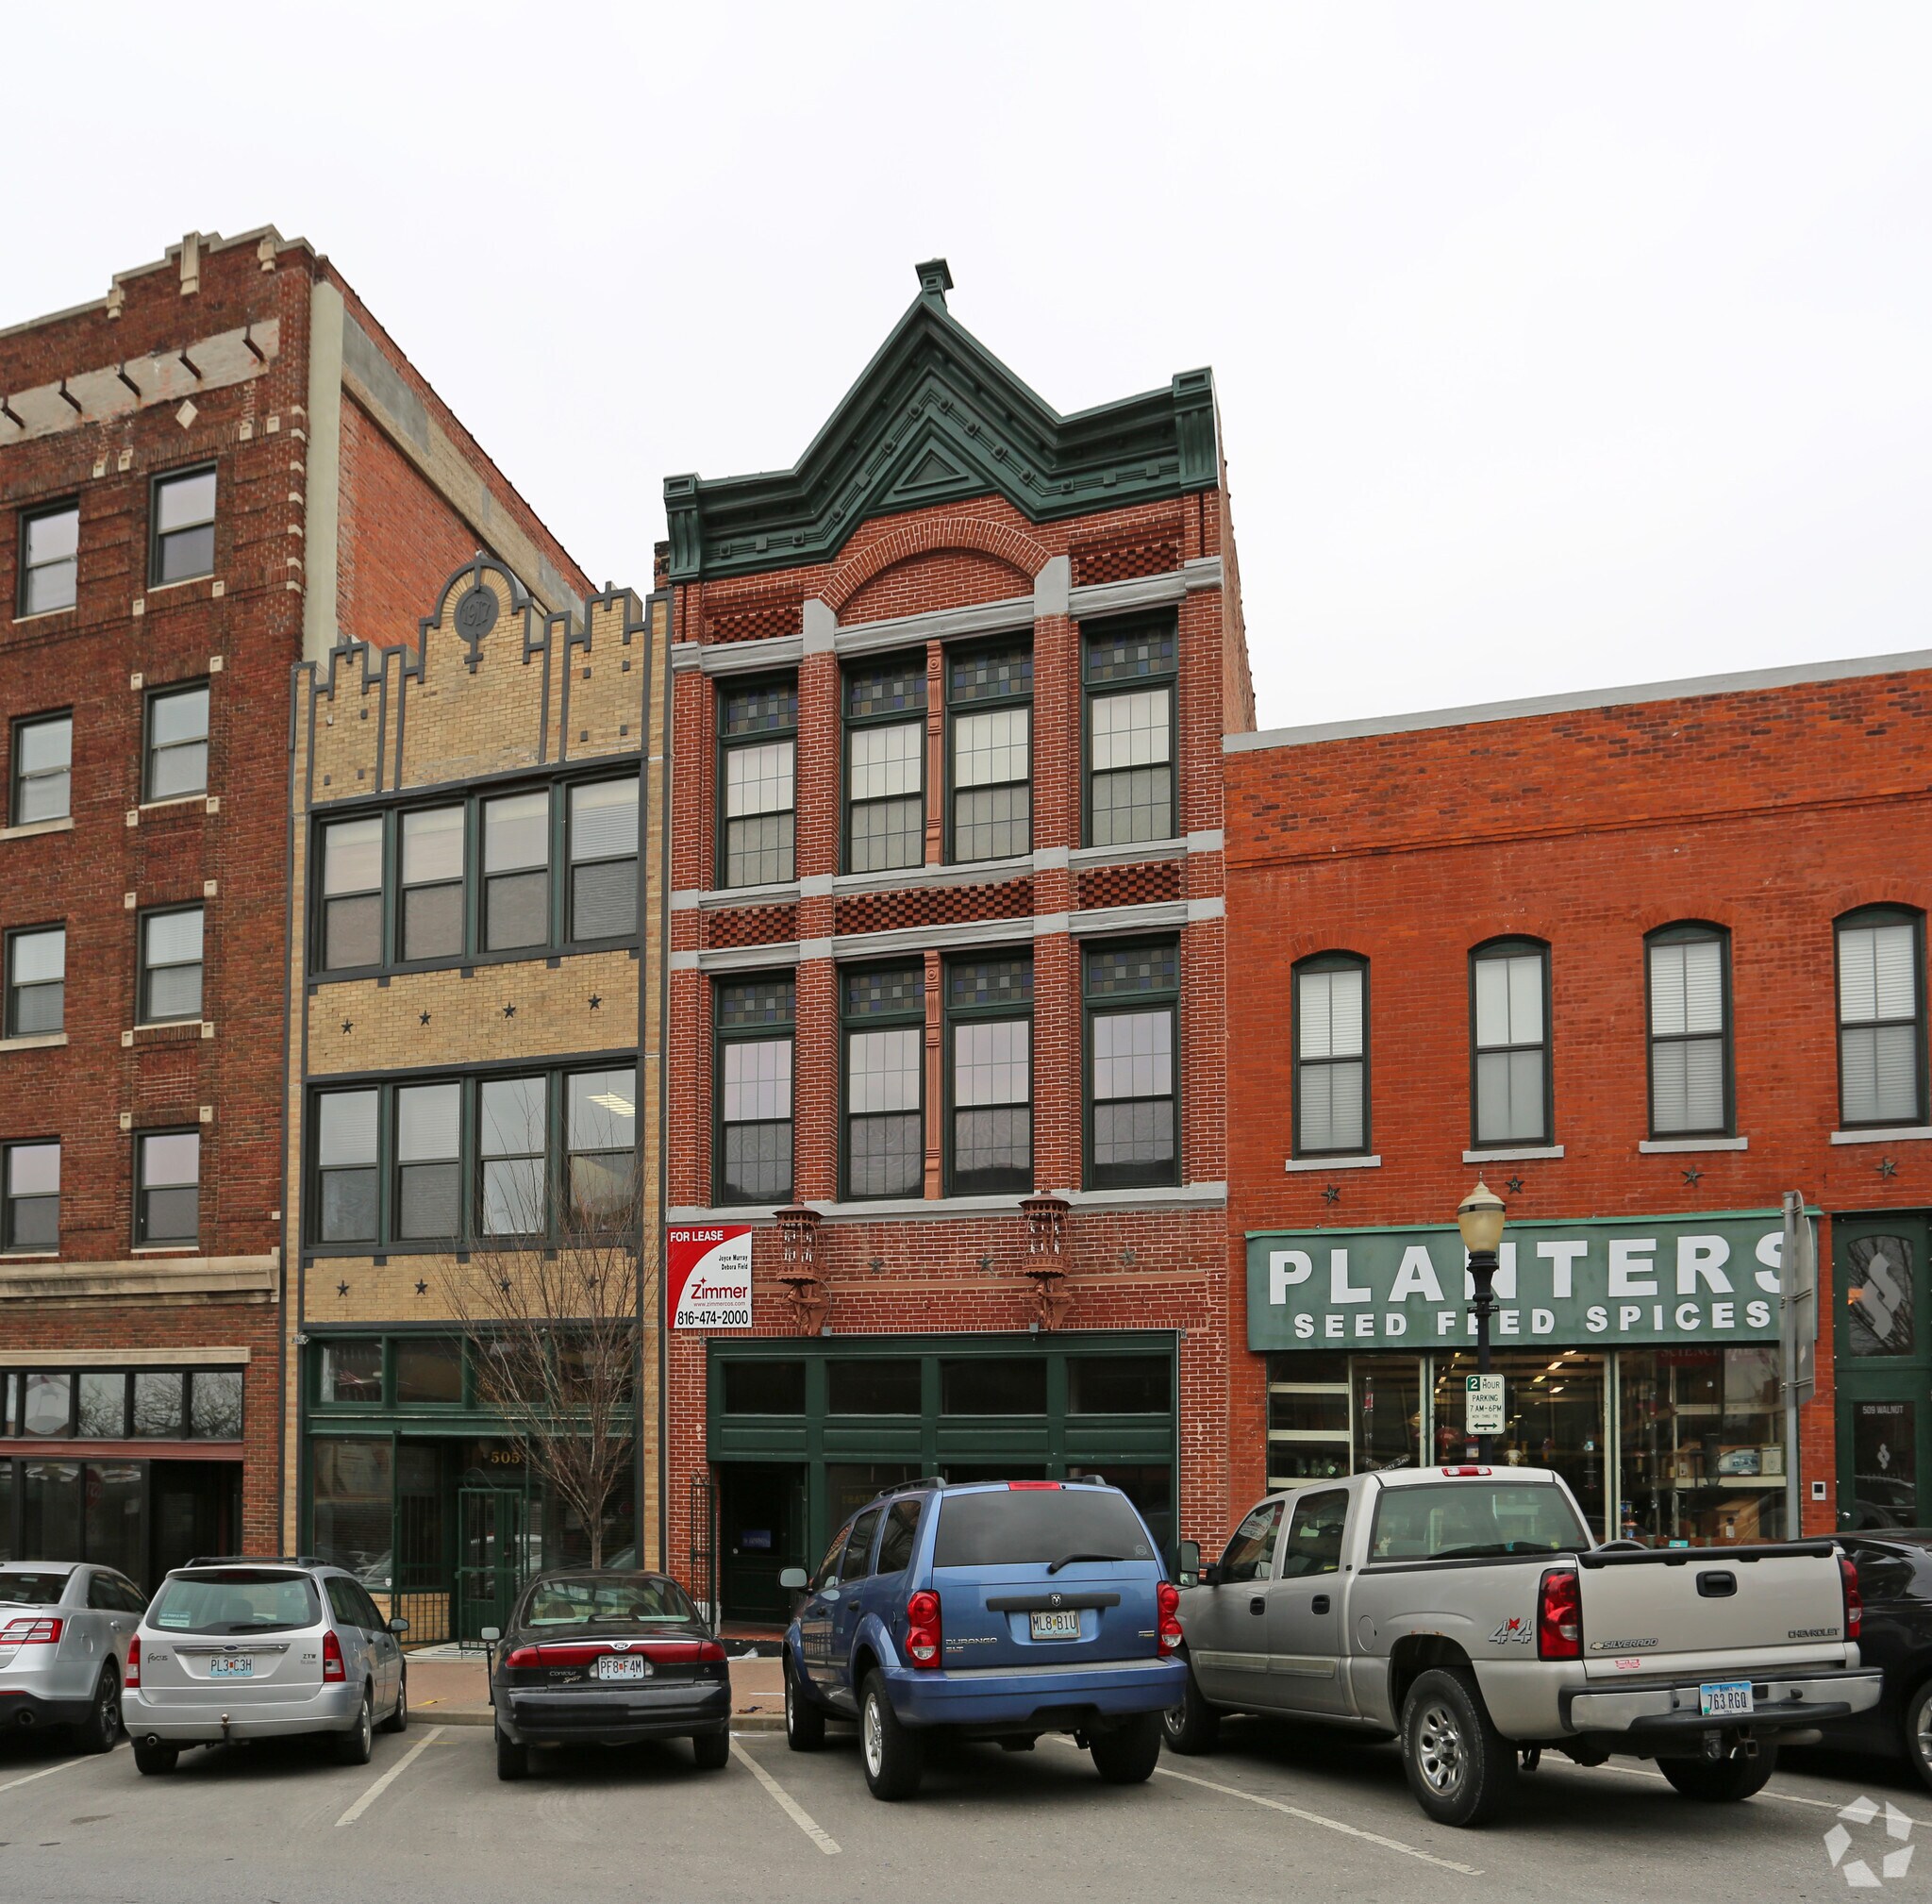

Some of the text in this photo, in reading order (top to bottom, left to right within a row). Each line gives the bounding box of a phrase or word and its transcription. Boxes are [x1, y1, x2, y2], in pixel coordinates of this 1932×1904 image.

[462, 601, 491, 627] 1917
[670, 1230, 724, 1243] FOR LEASE
[718, 1254, 748, 1263] Joyce Murray
[1269, 1230, 1785, 1306] PLANTERS
[691, 1281, 748, 1300] Zimmer
[677, 1310, 749, 1326] 816-474-2000
[1293, 1300, 1771, 1339] SEED FEED SPICES
[1470, 1378, 1478, 1390] 2
[1862, 1405, 1904, 1414] 509 WALNUT
[491, 1450, 521, 1464] 505
[1788, 1628, 1840, 1639] CHEVROLET
[945, 1637, 998, 1645] DURANGO
[1602, 1637, 1658, 1650] SILVERADO
[210, 1659, 252, 1672] PL3 C3H
[600, 1659, 642, 1674] PF8 F4M
[1707, 1692, 1747, 1710] 763 RGQ
